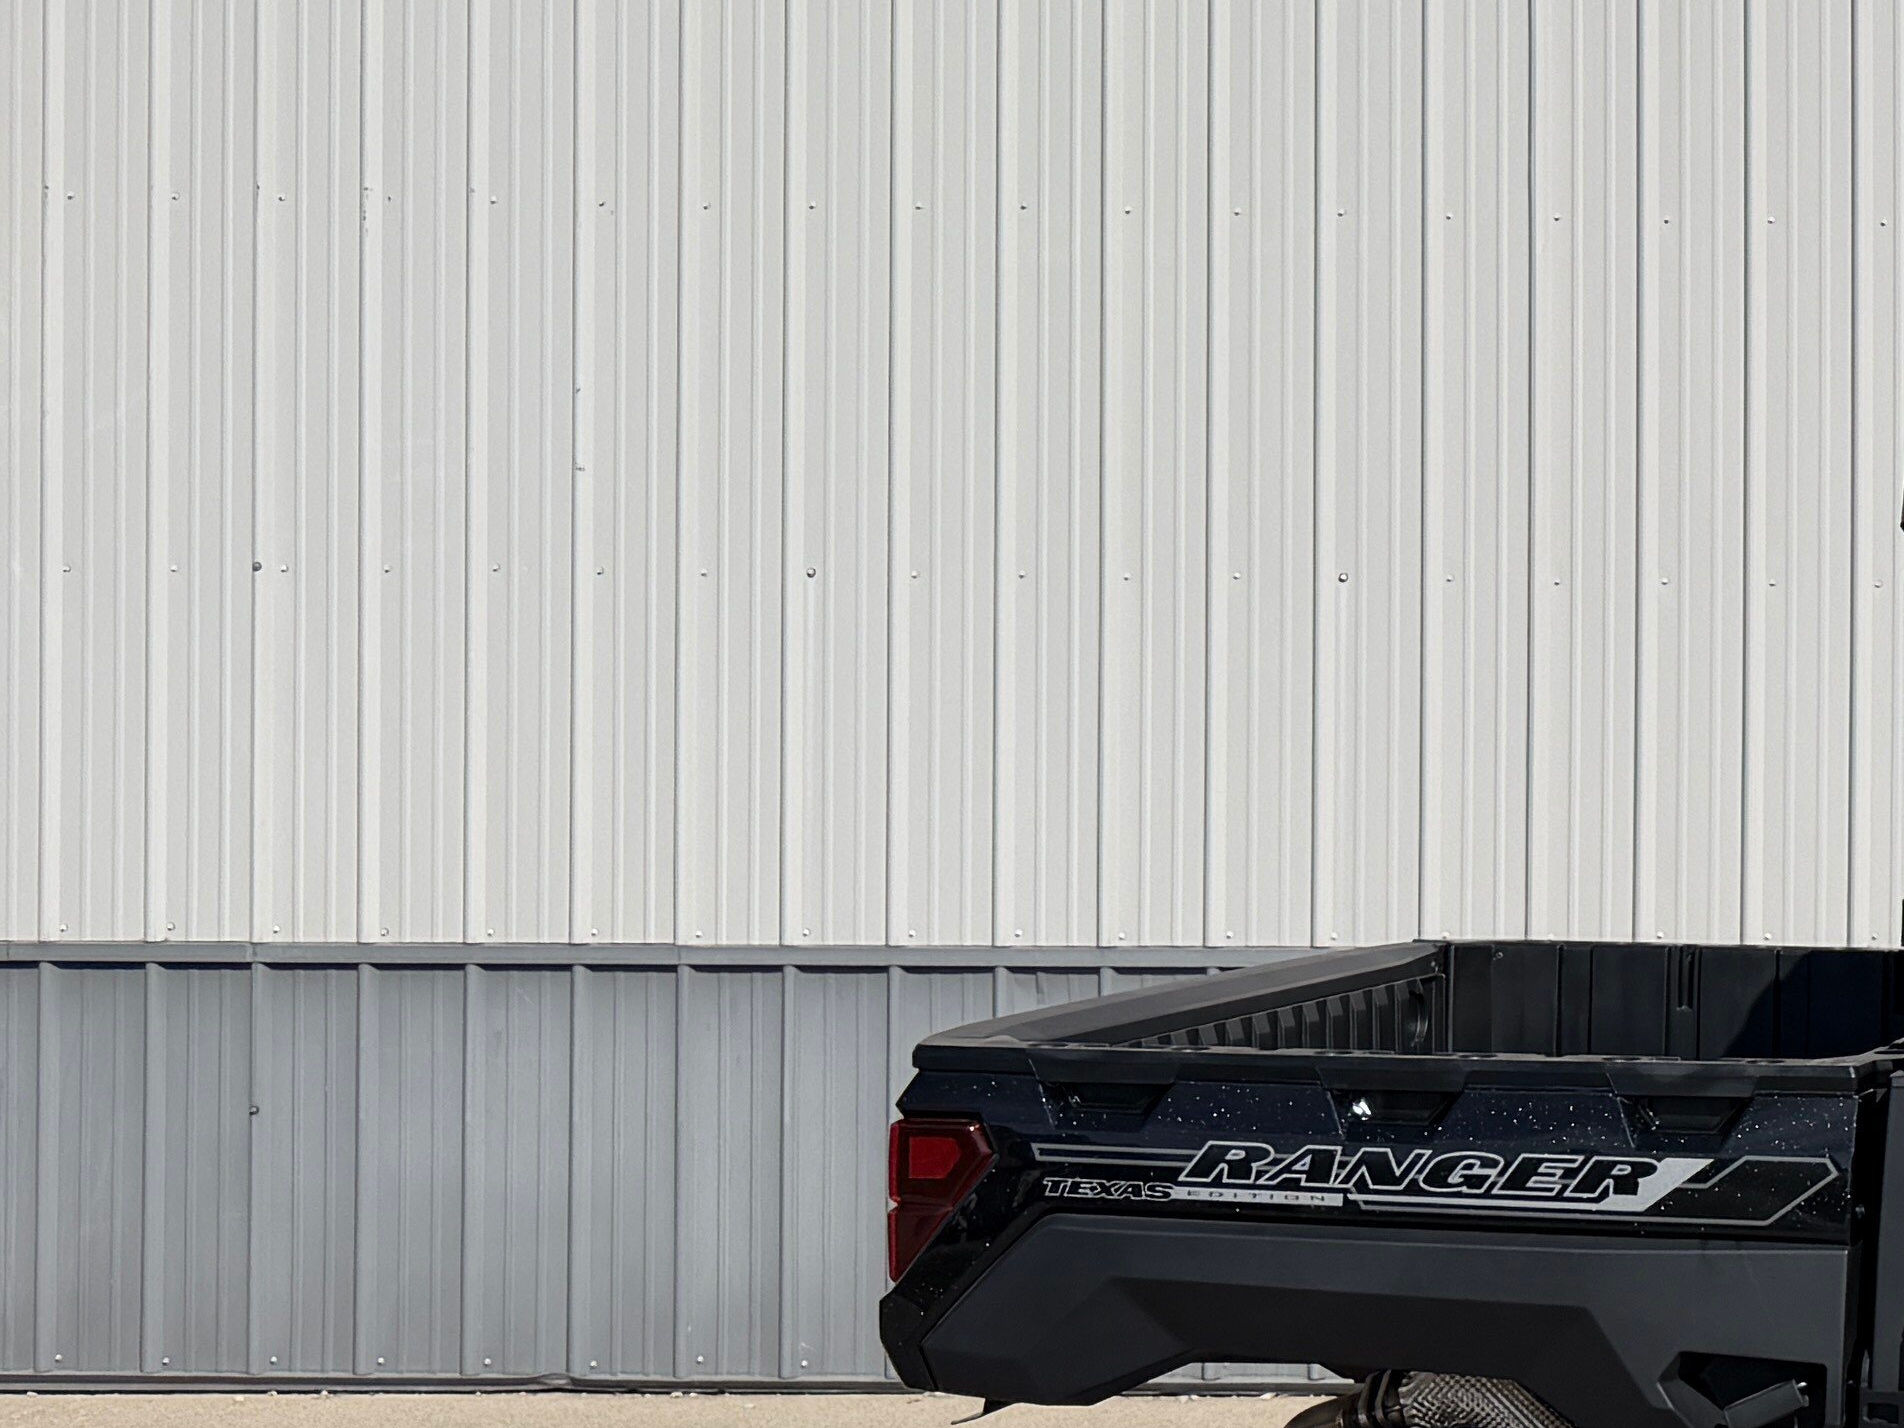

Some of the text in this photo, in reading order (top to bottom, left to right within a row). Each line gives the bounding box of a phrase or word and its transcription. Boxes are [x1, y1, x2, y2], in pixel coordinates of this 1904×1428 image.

[1043, 1176, 1327, 1204] TEXAS EDITION
[1177, 1139, 1661, 1204] RANGER
